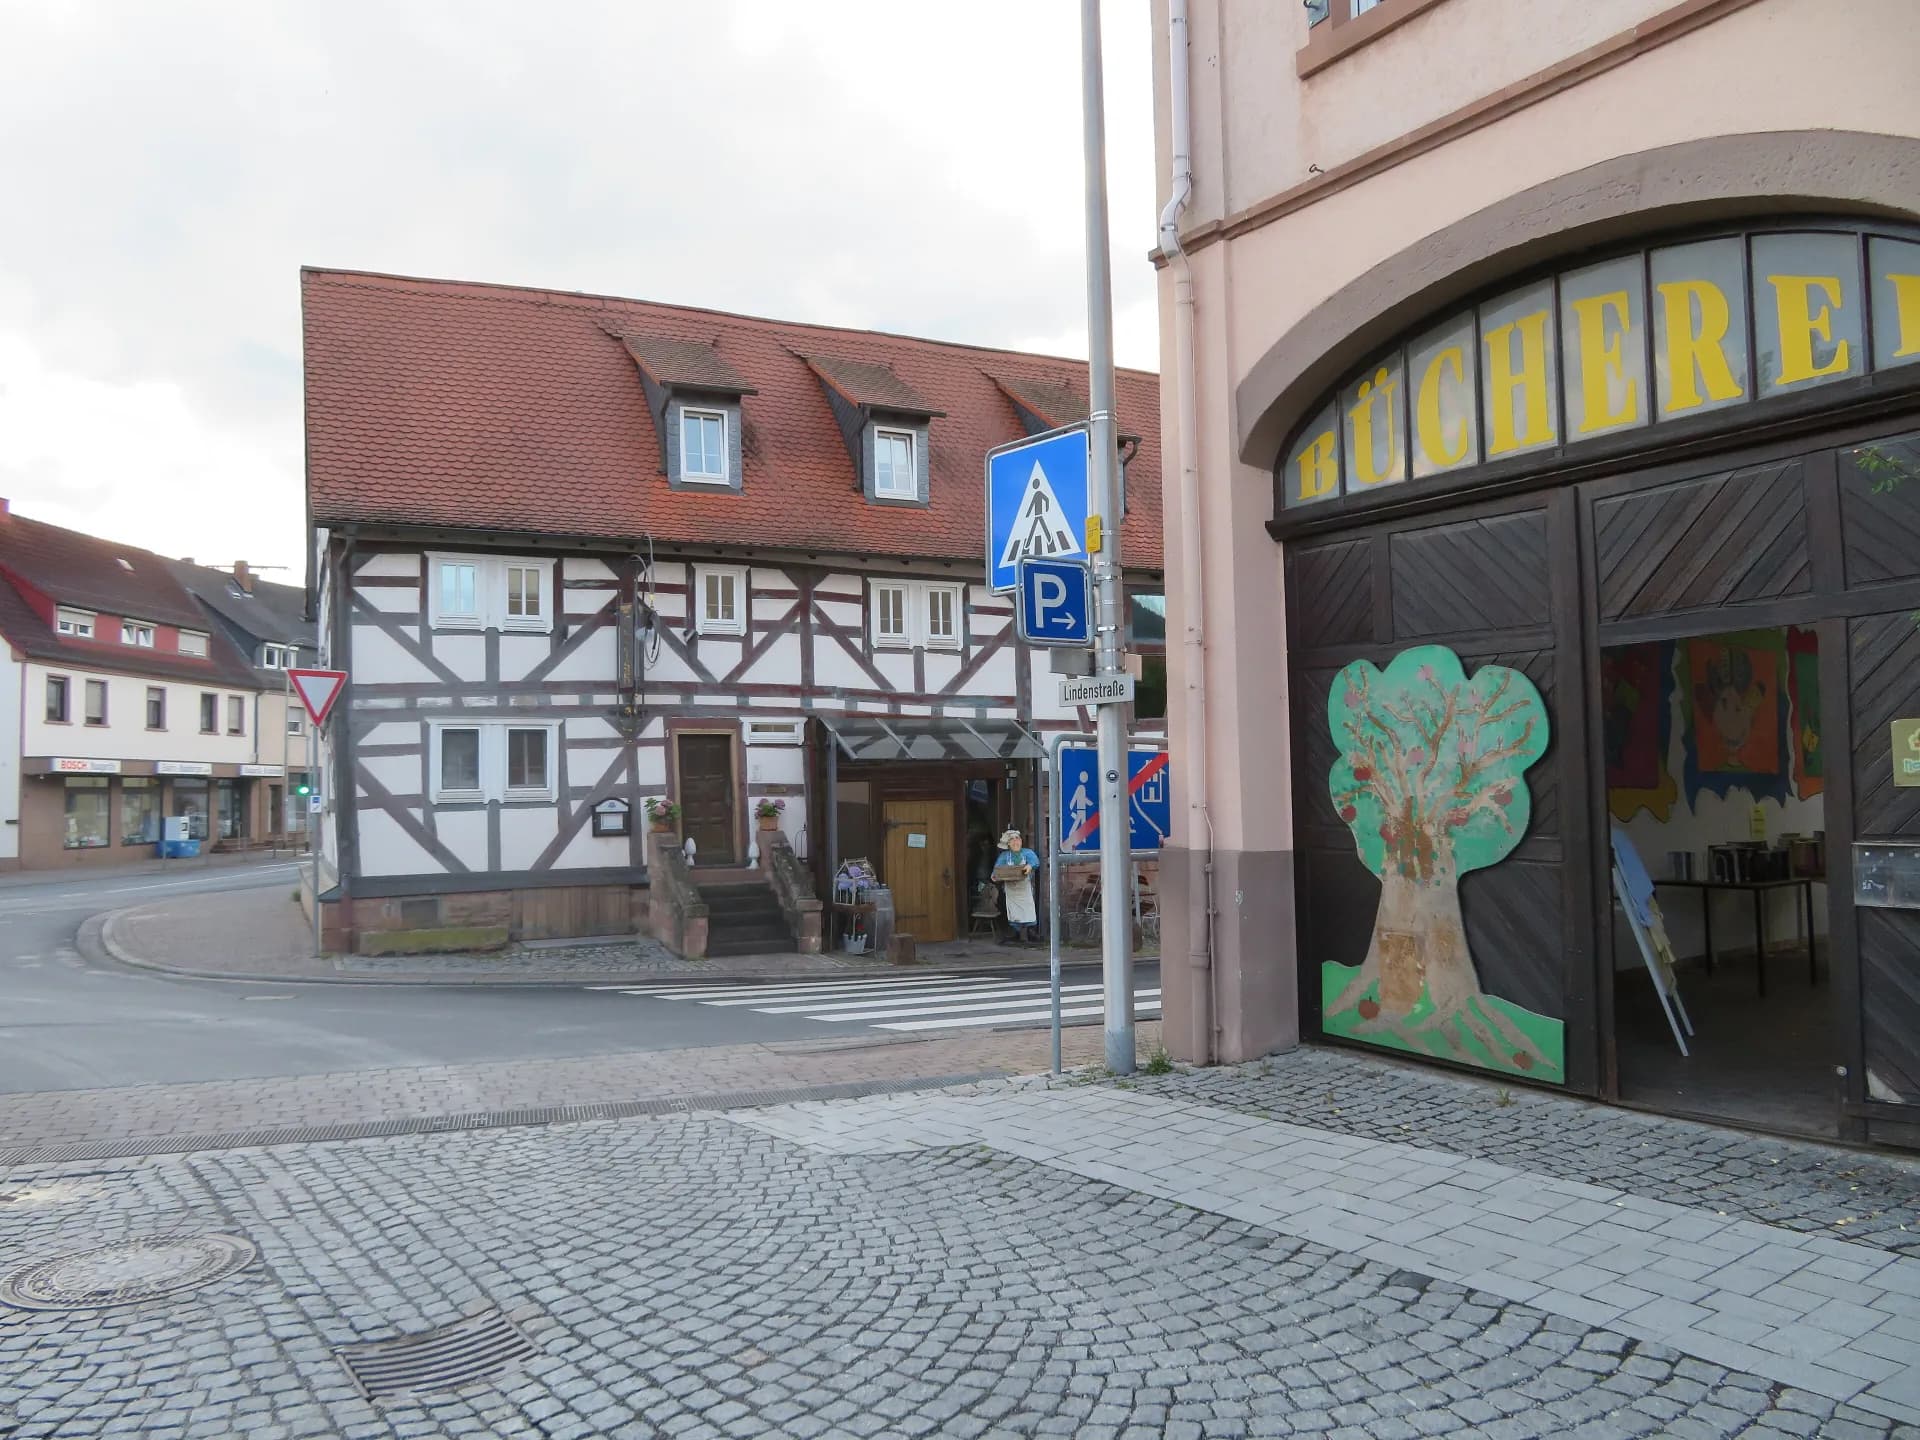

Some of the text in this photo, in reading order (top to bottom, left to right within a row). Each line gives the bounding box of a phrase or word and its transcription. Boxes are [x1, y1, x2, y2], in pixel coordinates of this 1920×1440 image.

[1034, 572, 1067, 629] P
[1064, 680, 1125, 701] Lindenstraße
[61, 760, 88, 770] BOSCH
